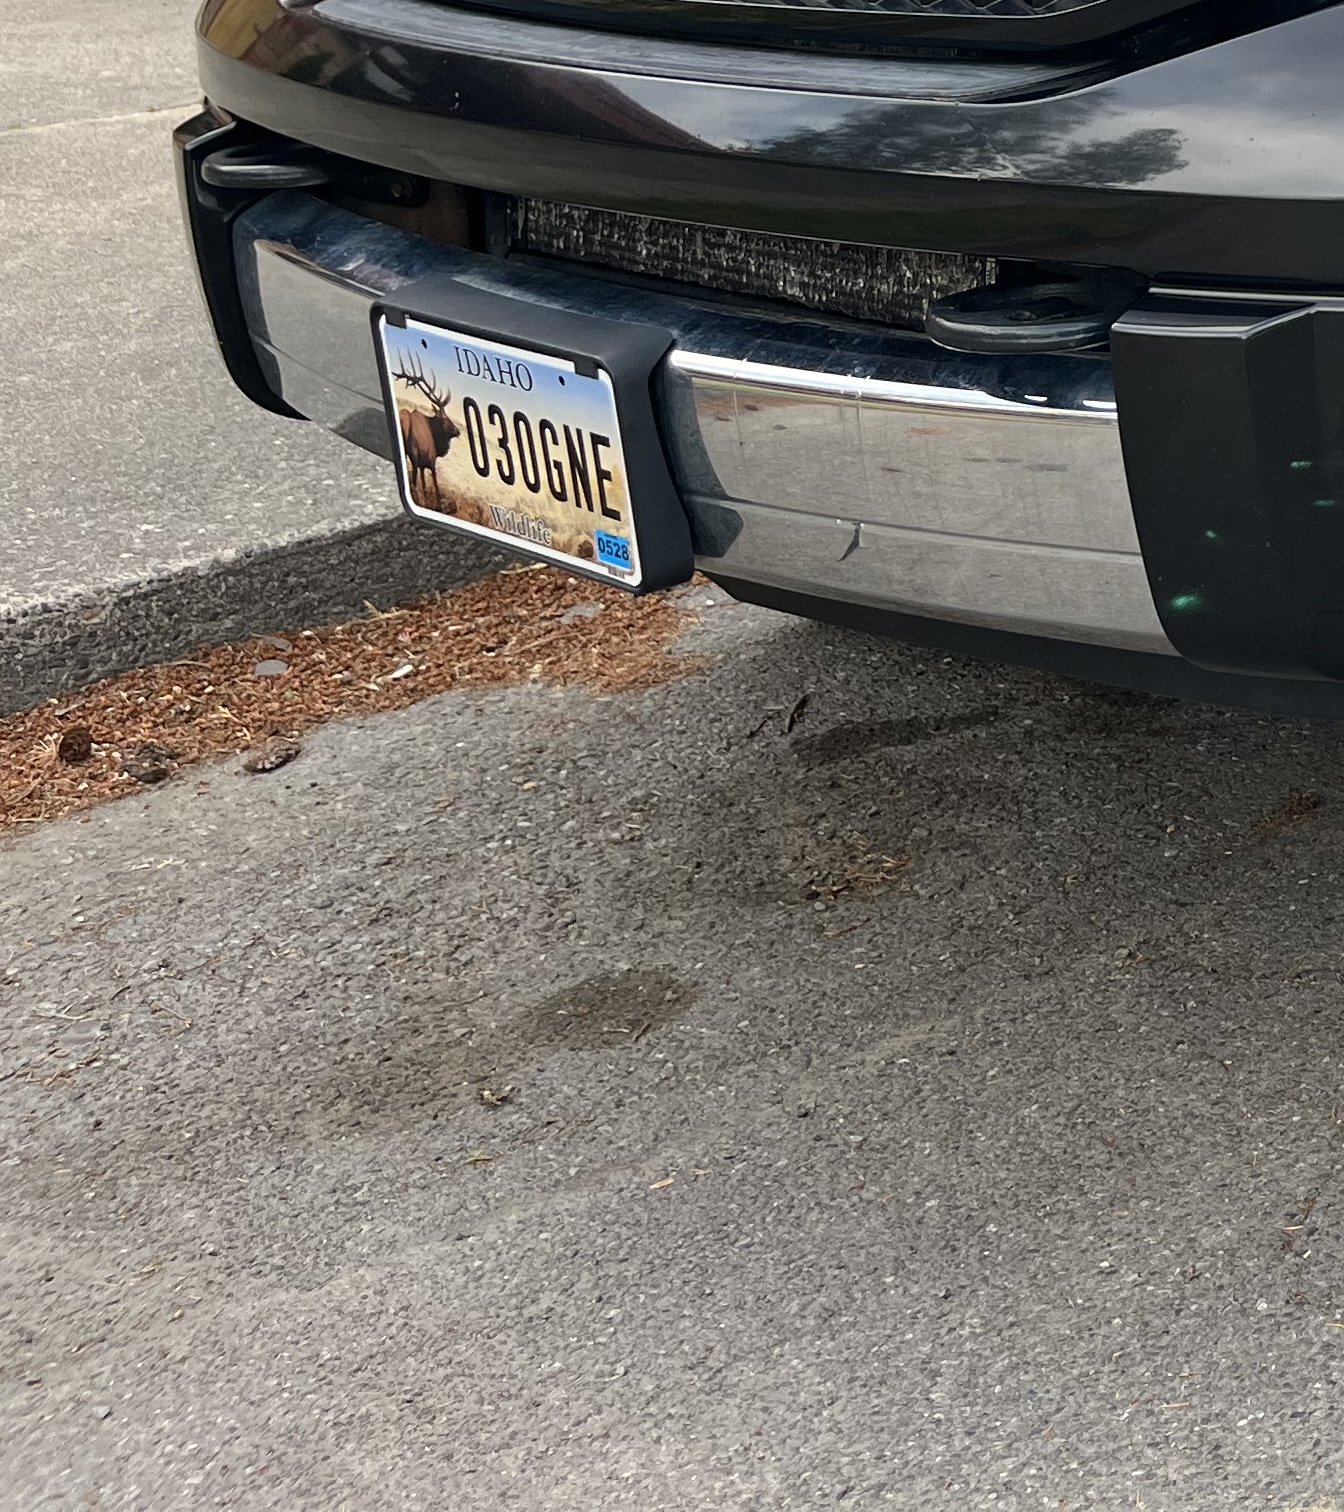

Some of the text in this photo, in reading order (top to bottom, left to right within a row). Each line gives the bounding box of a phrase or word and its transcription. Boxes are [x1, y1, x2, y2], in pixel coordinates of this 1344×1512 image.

[453, 346, 533, 392] IDAHO
[489, 504, 551, 546] Wildlife
[597, 536, 629, 562] 0528
